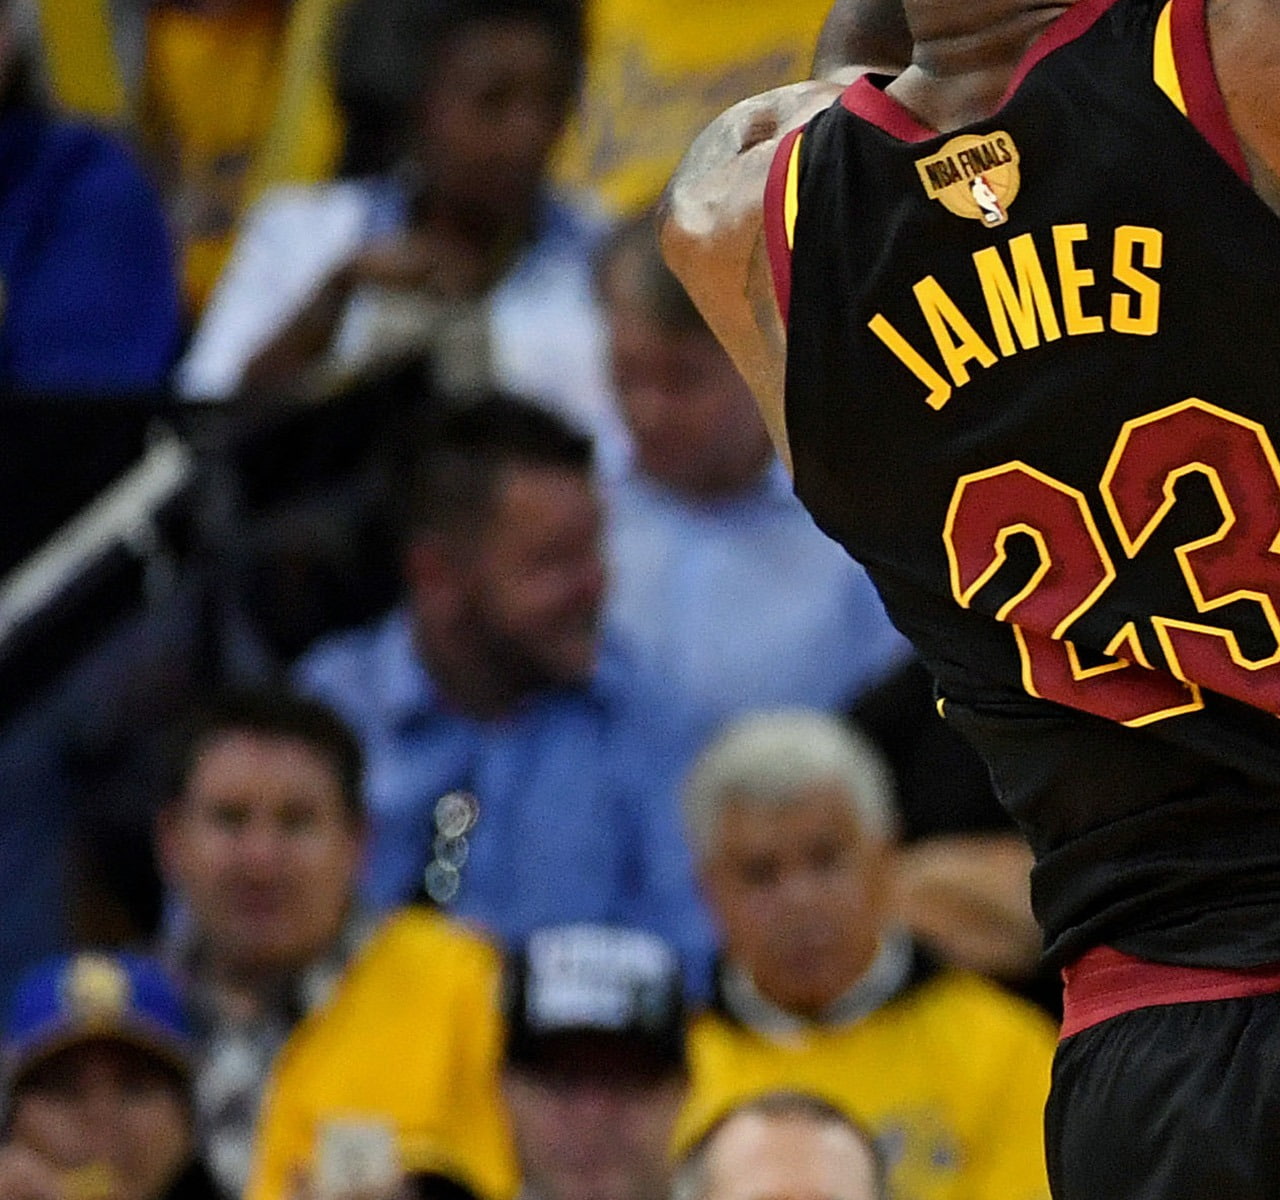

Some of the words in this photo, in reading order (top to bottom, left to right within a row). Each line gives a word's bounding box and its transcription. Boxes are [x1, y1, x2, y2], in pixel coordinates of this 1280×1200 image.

[924, 156, 963, 191] NBA
[957, 137, 1013, 179] FINALS
[867, 223, 1164, 411] JAMES
